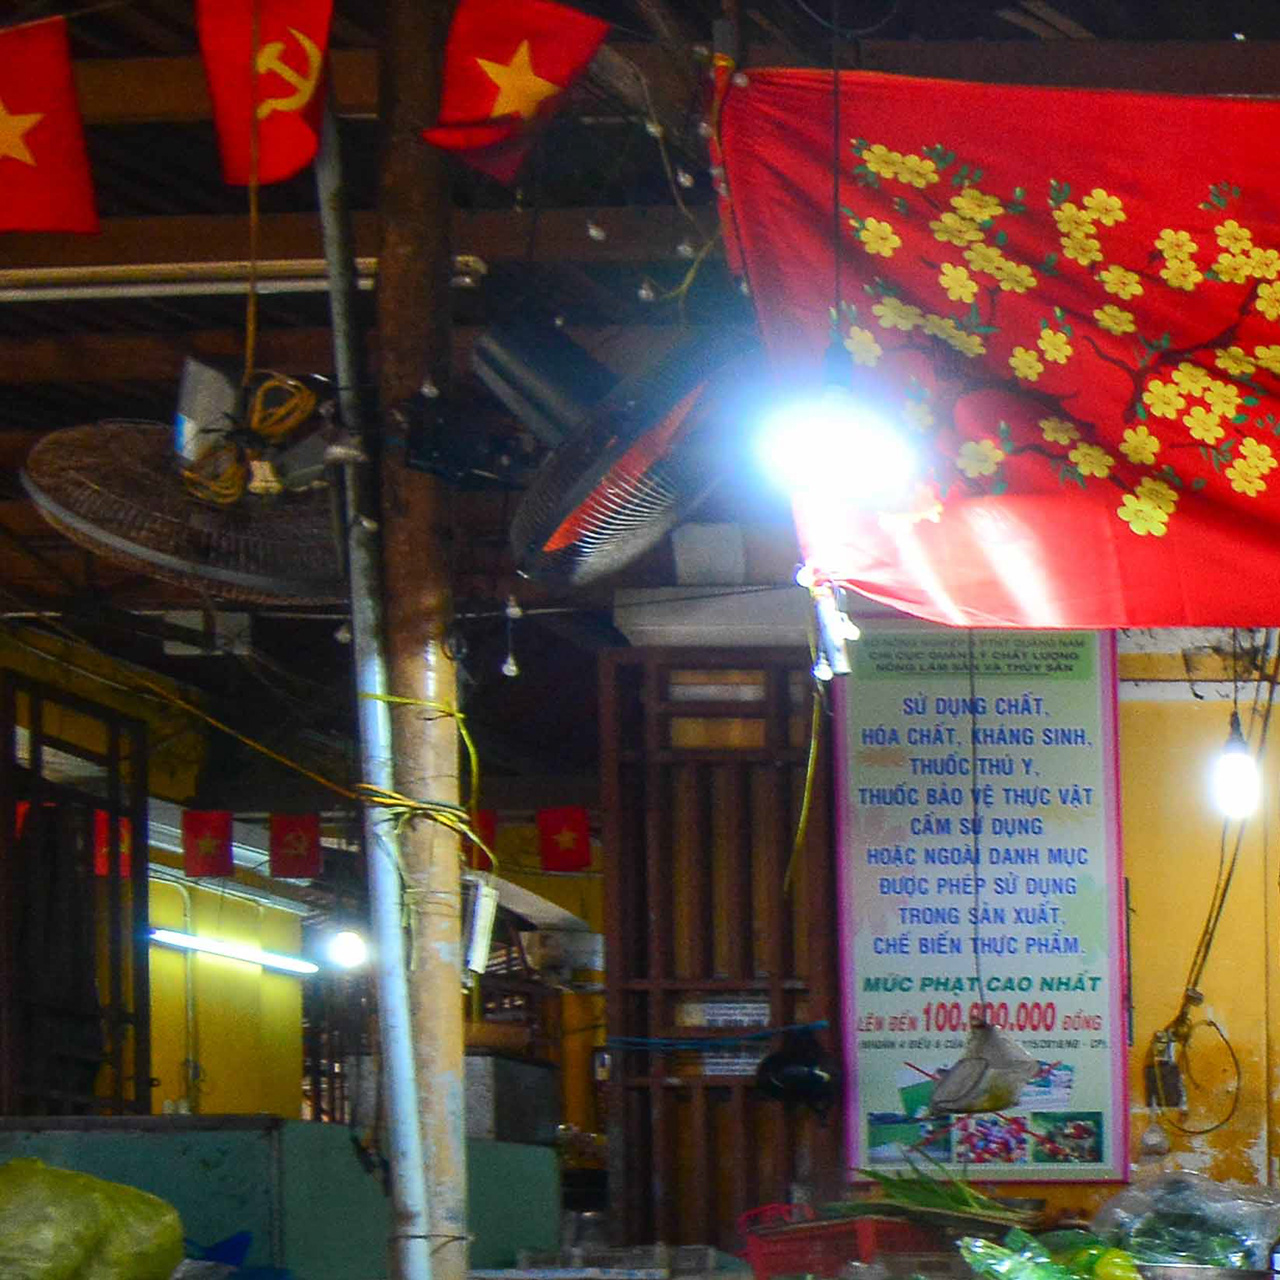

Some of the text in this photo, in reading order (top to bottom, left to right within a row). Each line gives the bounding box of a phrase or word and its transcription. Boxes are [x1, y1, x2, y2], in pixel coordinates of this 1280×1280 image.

[935, 697, 987, 719] DỤNG
[862, 724, 899, 746] HÓA
[972, 724, 1034, 746] KHÁNG
[1042, 727, 1094, 747] SINH,
[909, 752, 970, 776] THUỐC
[1022, 757, 1041, 777] Y,
[858, 782, 919, 806] THUỐC
[972, 784, 994, 808] VỆ
[1001, 786, 1051, 808] THỰC
[1058, 785, 1094, 809] VẬT
[992, 817, 1044, 839] DỤNG
[867, 844, 917, 868] HOẶC
[989, 848, 1040, 865] DANH
[1048, 848, 1089, 868] MỤC
[1026, 878, 1078, 898] DỤNG
[899, 907, 960, 925] TRONG
[873, 930, 910, 955] CHẾ
[919, 930, 962, 955] BIẾN
[969, 937, 1018, 957] THỰC
[919, 976, 980, 996] PHẠT
[986, 976, 1034, 992] CAO
[857, 1012, 883, 1032] LÊN
